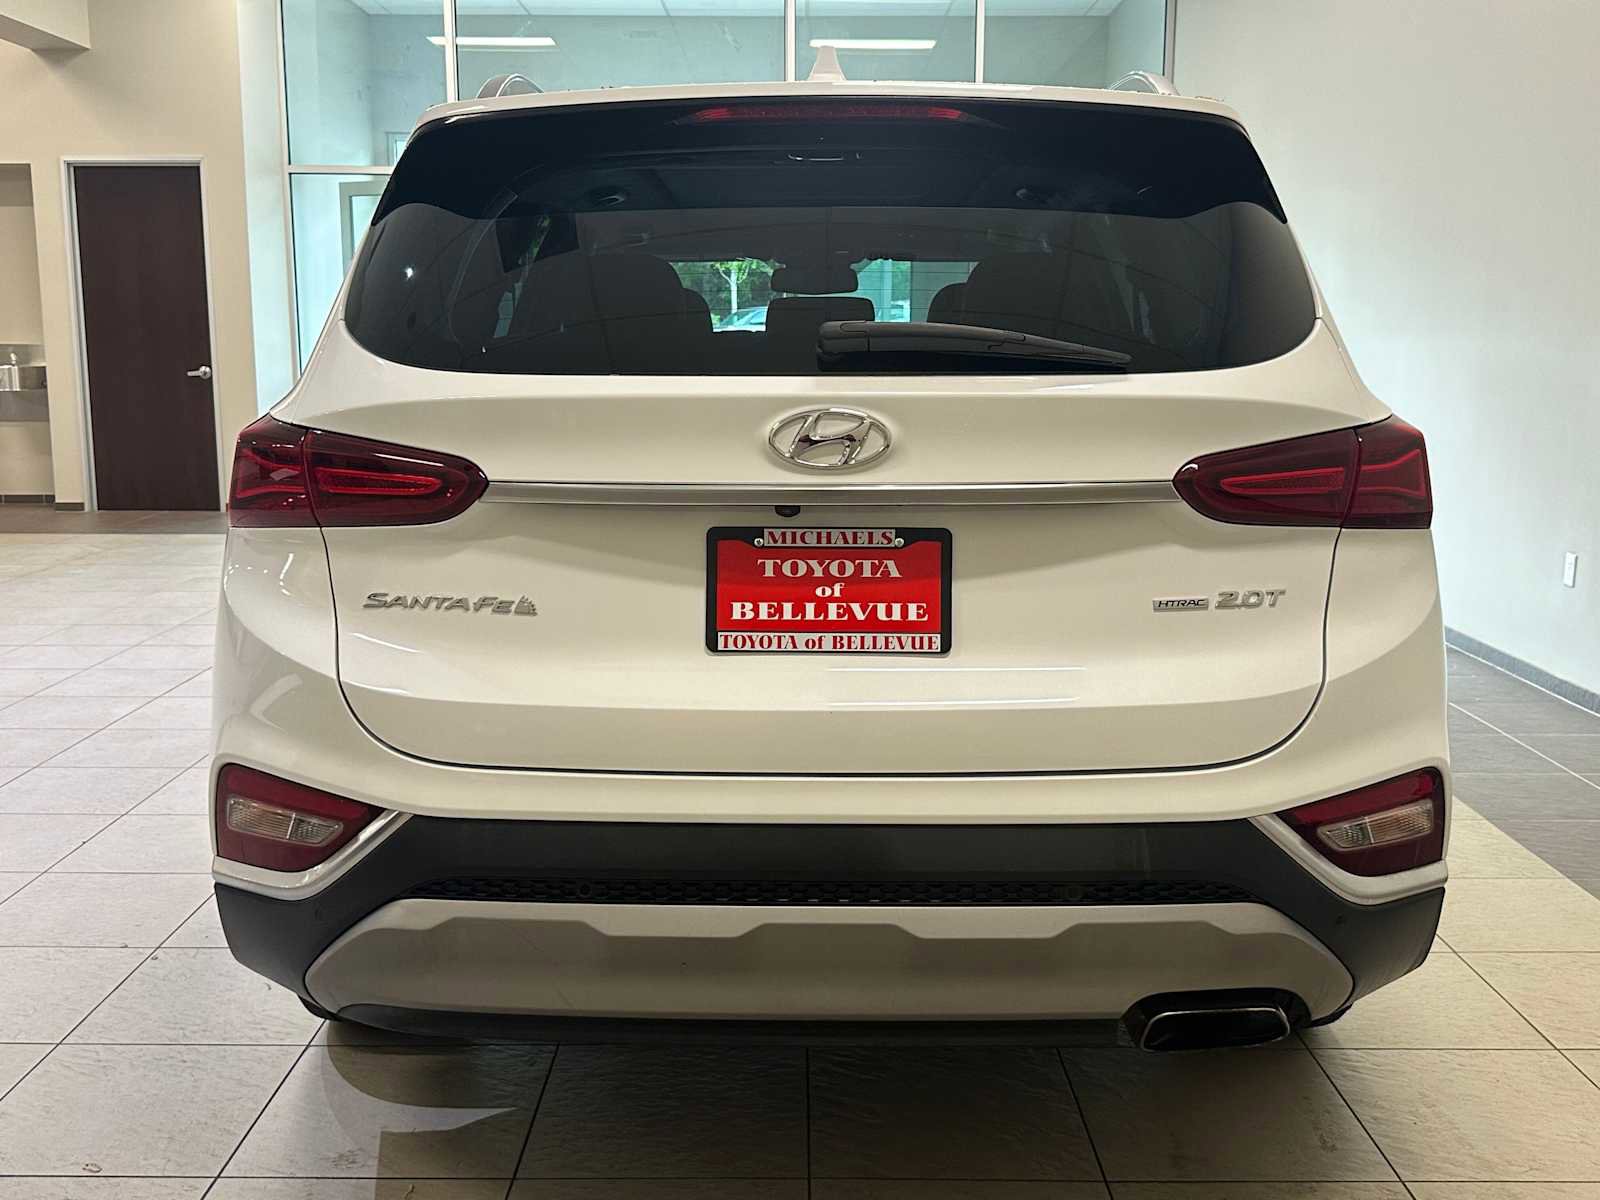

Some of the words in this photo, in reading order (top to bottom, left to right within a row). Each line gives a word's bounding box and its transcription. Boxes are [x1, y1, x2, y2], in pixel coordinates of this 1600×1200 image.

[767, 530, 893, 545] MICHAELS
[757, 559, 902, 577] TOYOTA
[815, 582, 845, 598] of
[731, 602, 929, 621] BELLEVUE
[1158, 599, 1208, 608] HTRAC
[720, 634, 799, 650] TOYOTA
[804, 633, 826, 650] of
[832, 634, 940, 650] BELLEVUE
